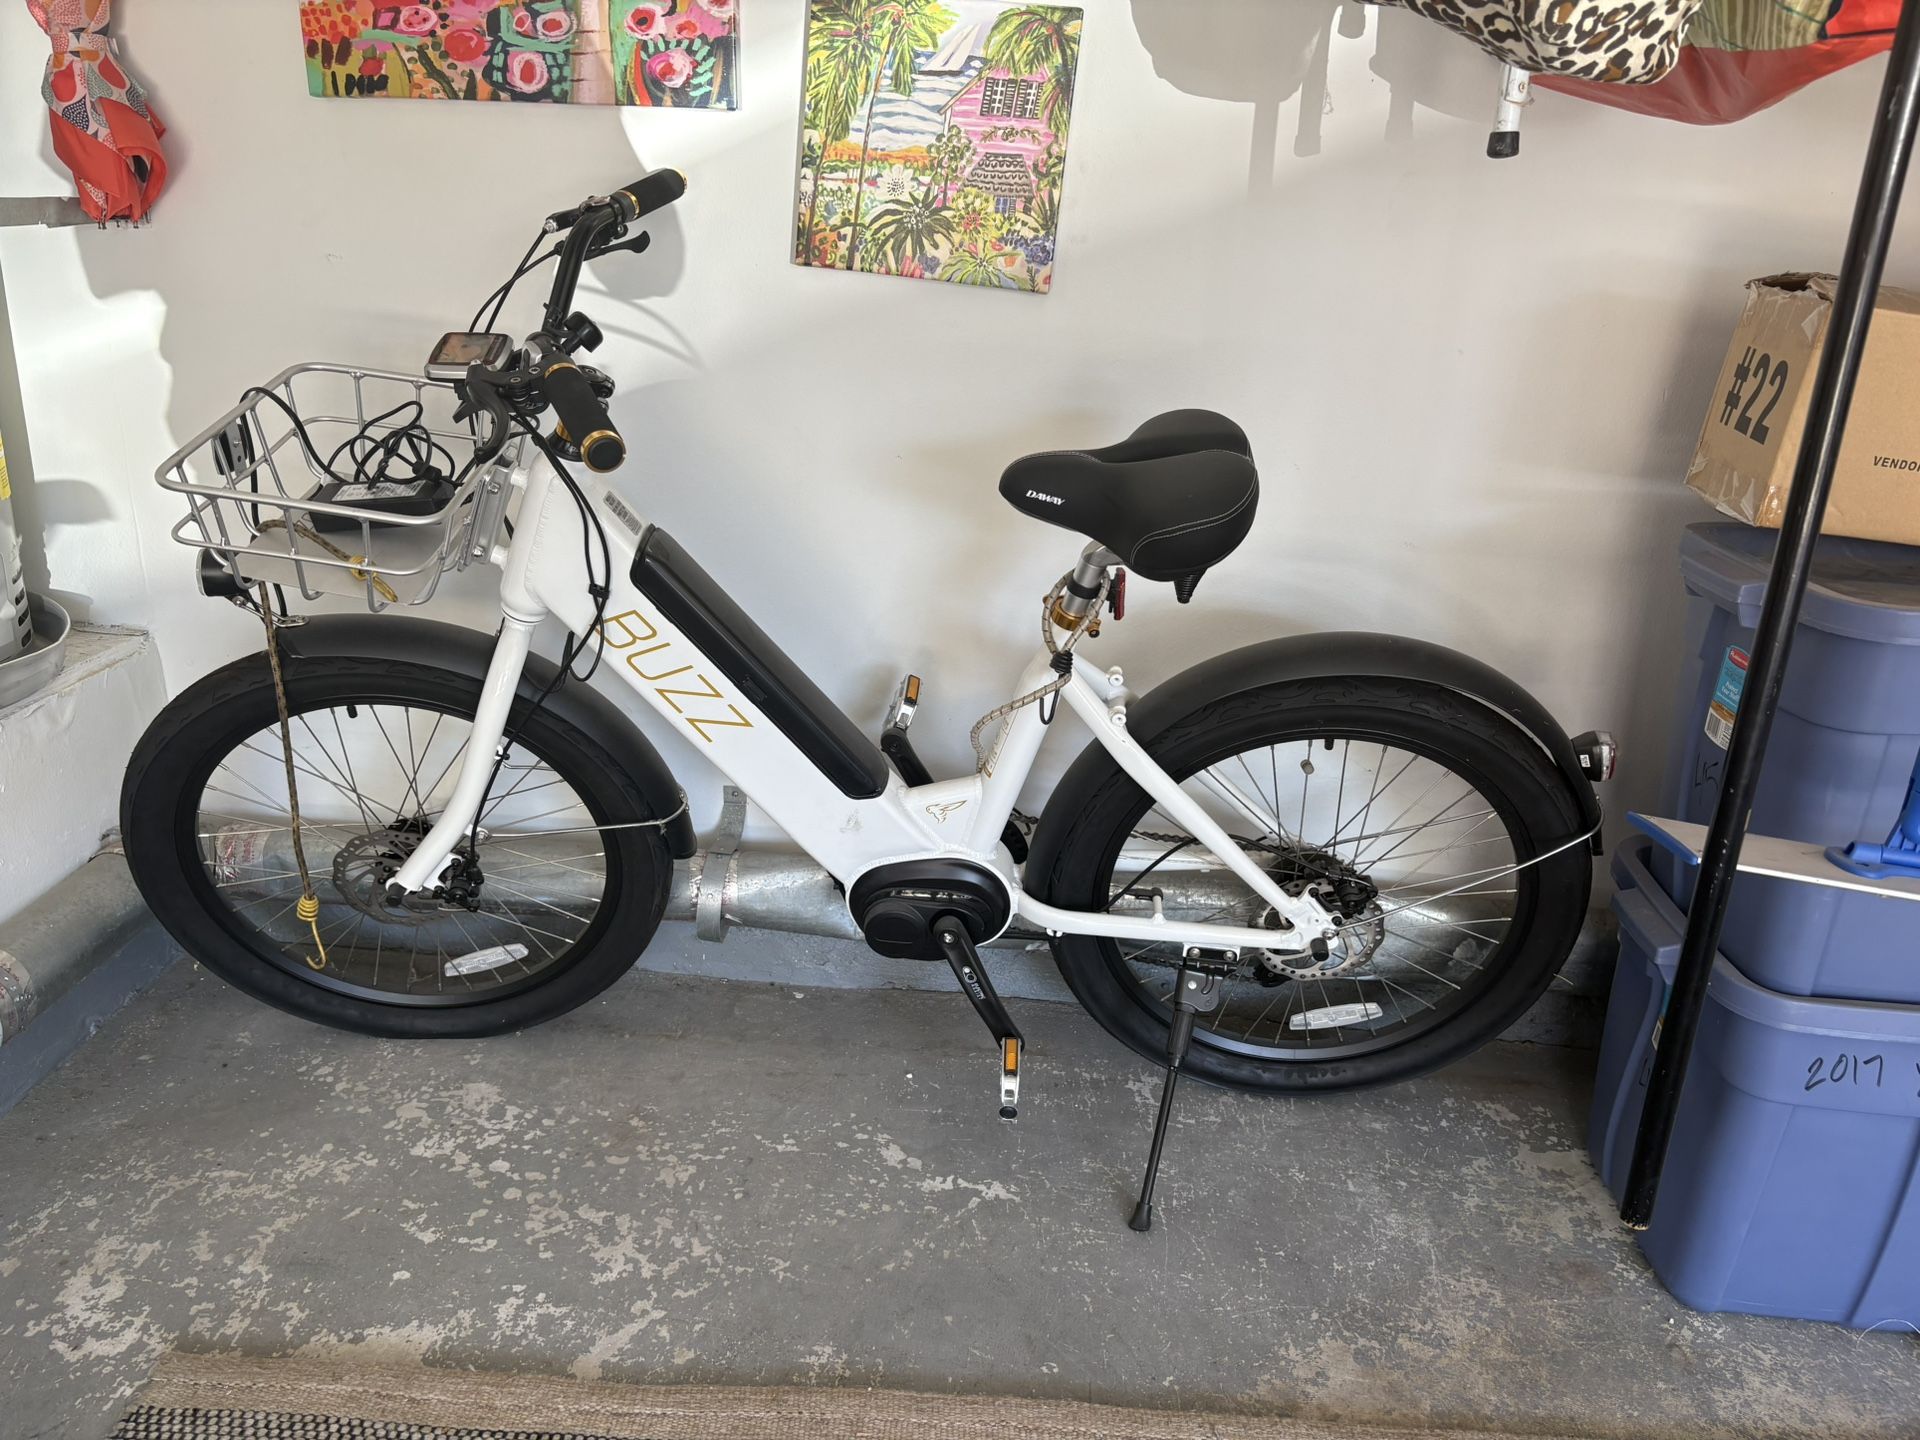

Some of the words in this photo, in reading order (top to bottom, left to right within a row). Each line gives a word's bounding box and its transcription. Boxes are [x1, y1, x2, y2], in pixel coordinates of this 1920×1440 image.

[1720, 346, 1788, 445] #22
[1026, 489, 1065, 505] DAWAY
[589, 610, 754, 743] BUZZ
[1804, 1053, 1883, 1091] 2017
